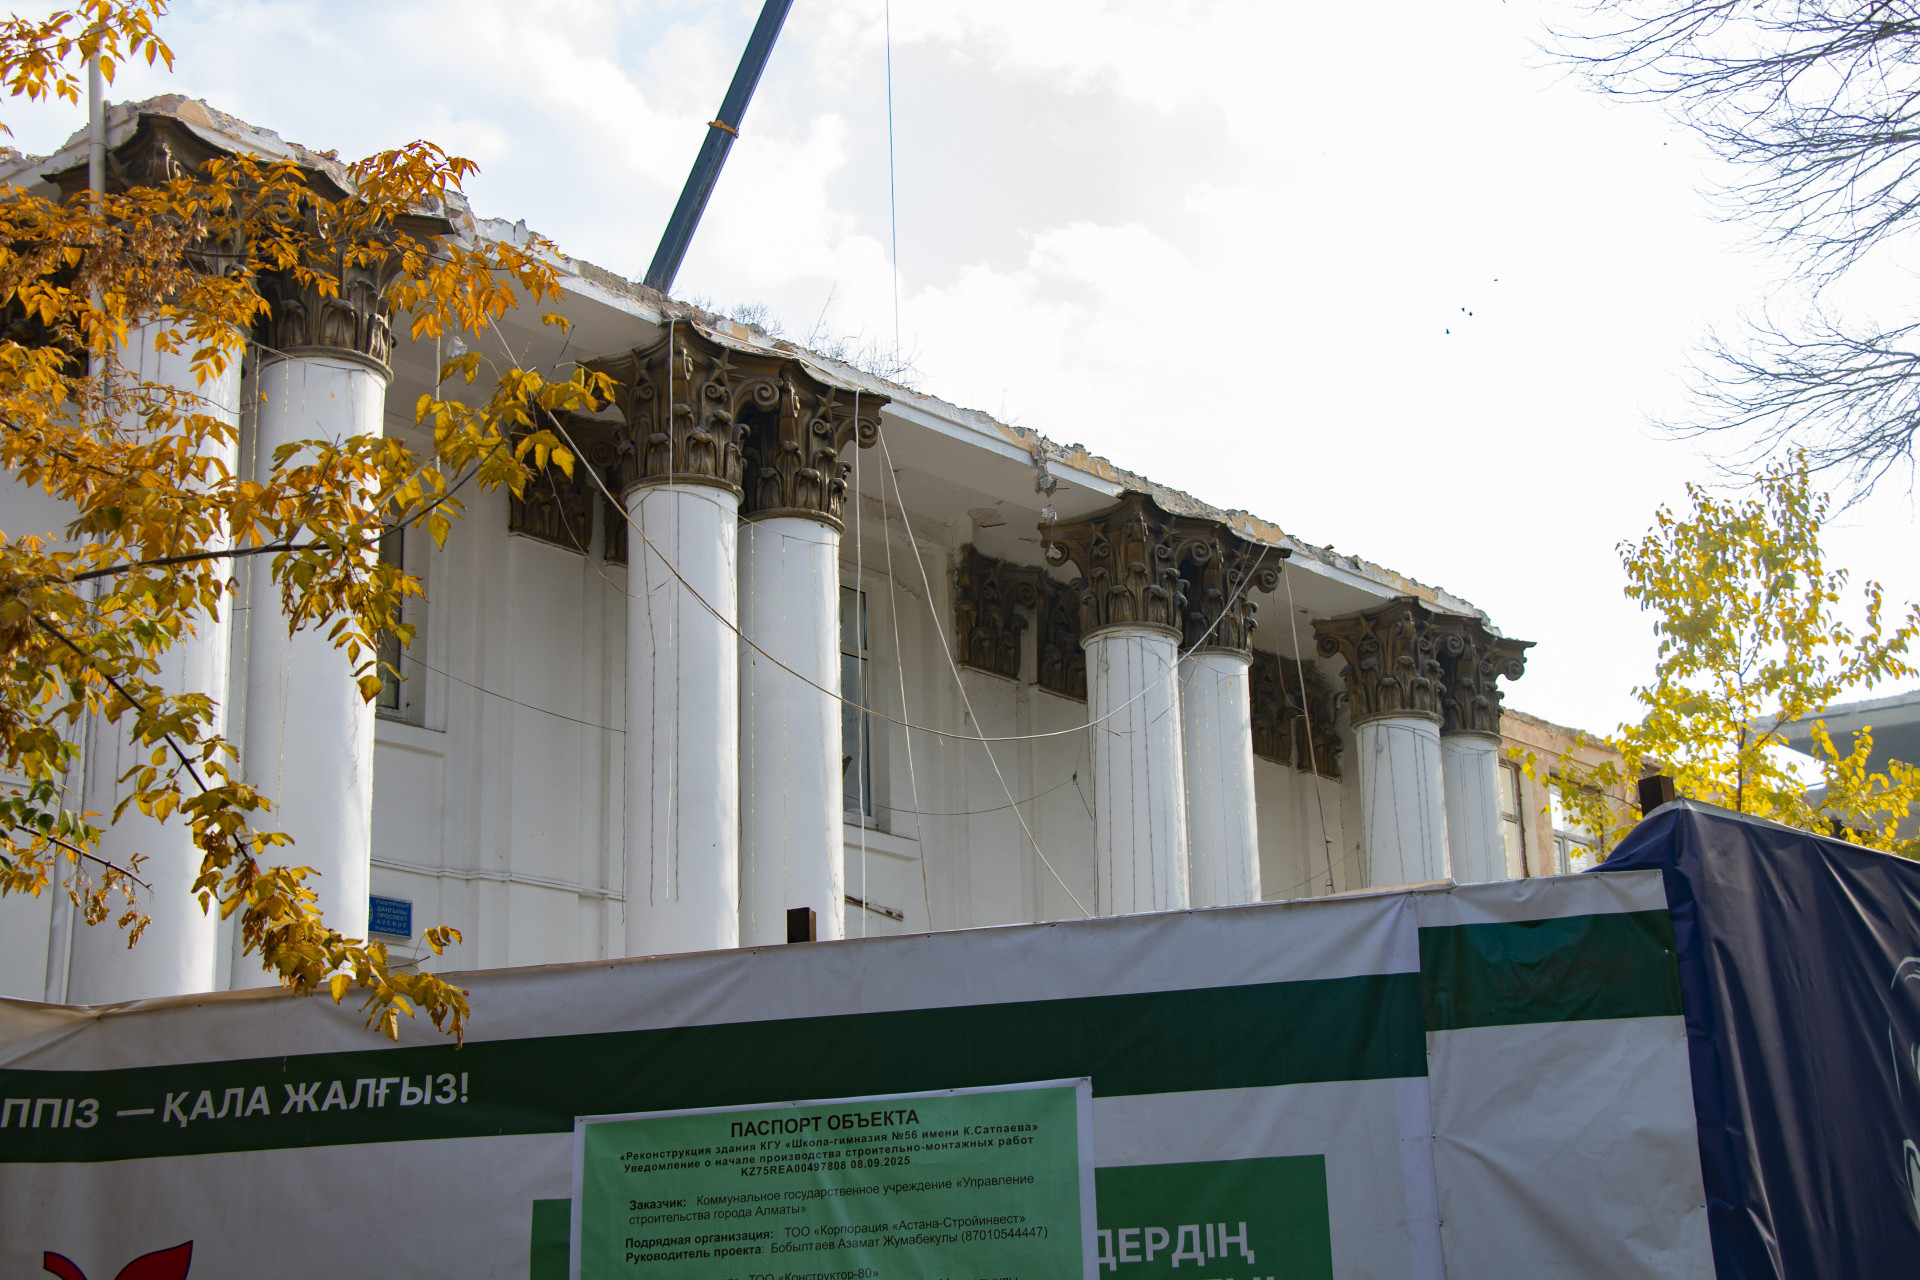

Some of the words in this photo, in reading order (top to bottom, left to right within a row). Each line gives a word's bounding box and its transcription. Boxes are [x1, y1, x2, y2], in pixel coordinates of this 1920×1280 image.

[377, 912, 407, 921] ПРОСПЕКТ
[377, 919, 407, 927] AVENUE
[162, 1085, 271, 1127] ҚАЛА
[280, 1072, 470, 1114] ЖАЛҒЫЗ!
[731, 1116, 822, 1138] ПАСПОРТ
[827, 1109, 920, 1130] ОБЪЕКТА
[620, 1147, 711, 1161] «Реконструкция
[715, 1144, 756, 1155] здания
[760, 1140, 781, 1151] КГУ
[785, 1134, 888, 1149] «Школа-гимназия
[892, 1130, 918, 1141] №56
[921, 1129, 959, 1139] имени
[963, 1124, 1038, 1136] К.Сатпаева»
[624, 1161, 701, 1173] Уведомление
[715, 1156, 755, 1167] начале
[759, 1150, 841, 1164] производства
[845, 1140, 994, 1157] строительно-монтажных
[998, 1136, 1034, 1148] работ
[740, 1161, 847, 1176] KZ75REA00497808
[850, 1156, 910, 1169] 08.09.2025
[629, 1199, 686, 1211] Заказчик:
[696, 1192, 781, 1207] Коммунальное
[784, 1185, 880, 1200] государственное
[883, 1180, 952, 1195] учреждение
[956, 1174, 1035, 1189] «Управление
[625, 1234, 691, 1250] Подрядная
[694, 1230, 774, 1245] организация:
[784, 1226, 810, 1238] ТОО
[814, 1222, 888, 1237] «Корпорация
[892, 1214, 1026, 1231] «Астана-Стройинвест»
[629, 1211, 710, 1227] строительства
[713, 1208, 752, 1220] города
[755, 1204, 807, 1217] Алматы»
[625, 1249, 710, 1264] Руководитель
[713, 1245, 764, 1259] проекта:
[771, 1241, 835, 1254] Бобылтаев
[837, 1237, 880, 1249] Азамат
[883, 1233, 958, 1248] Жумабекулы
[961, 1226, 1049, 1244] (87010544447)
